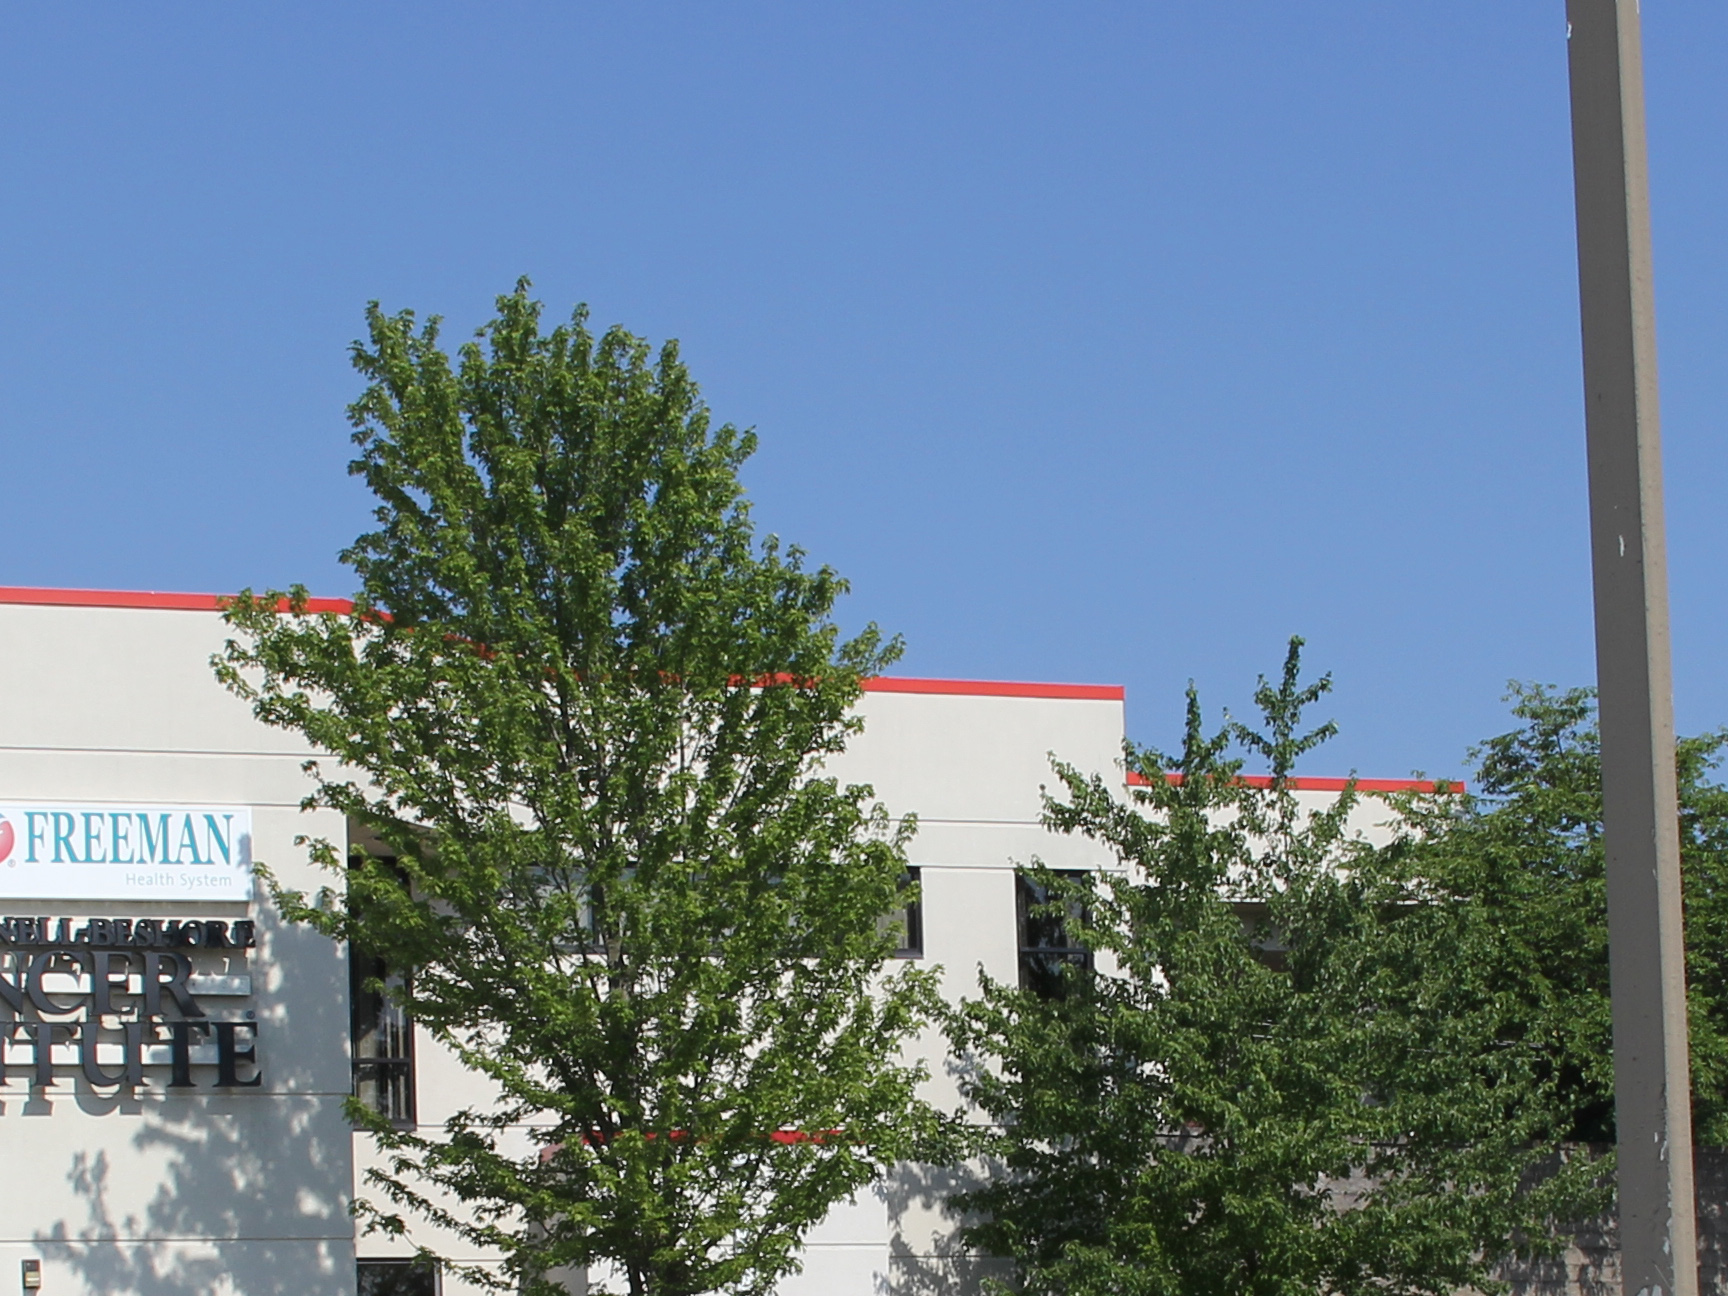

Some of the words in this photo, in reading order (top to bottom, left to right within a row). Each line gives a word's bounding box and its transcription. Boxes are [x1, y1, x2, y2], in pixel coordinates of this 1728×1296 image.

[24, 811, 234, 865] FREEMAN
[126, 873, 174, 886] Health
[180, 873, 232, 889] System
